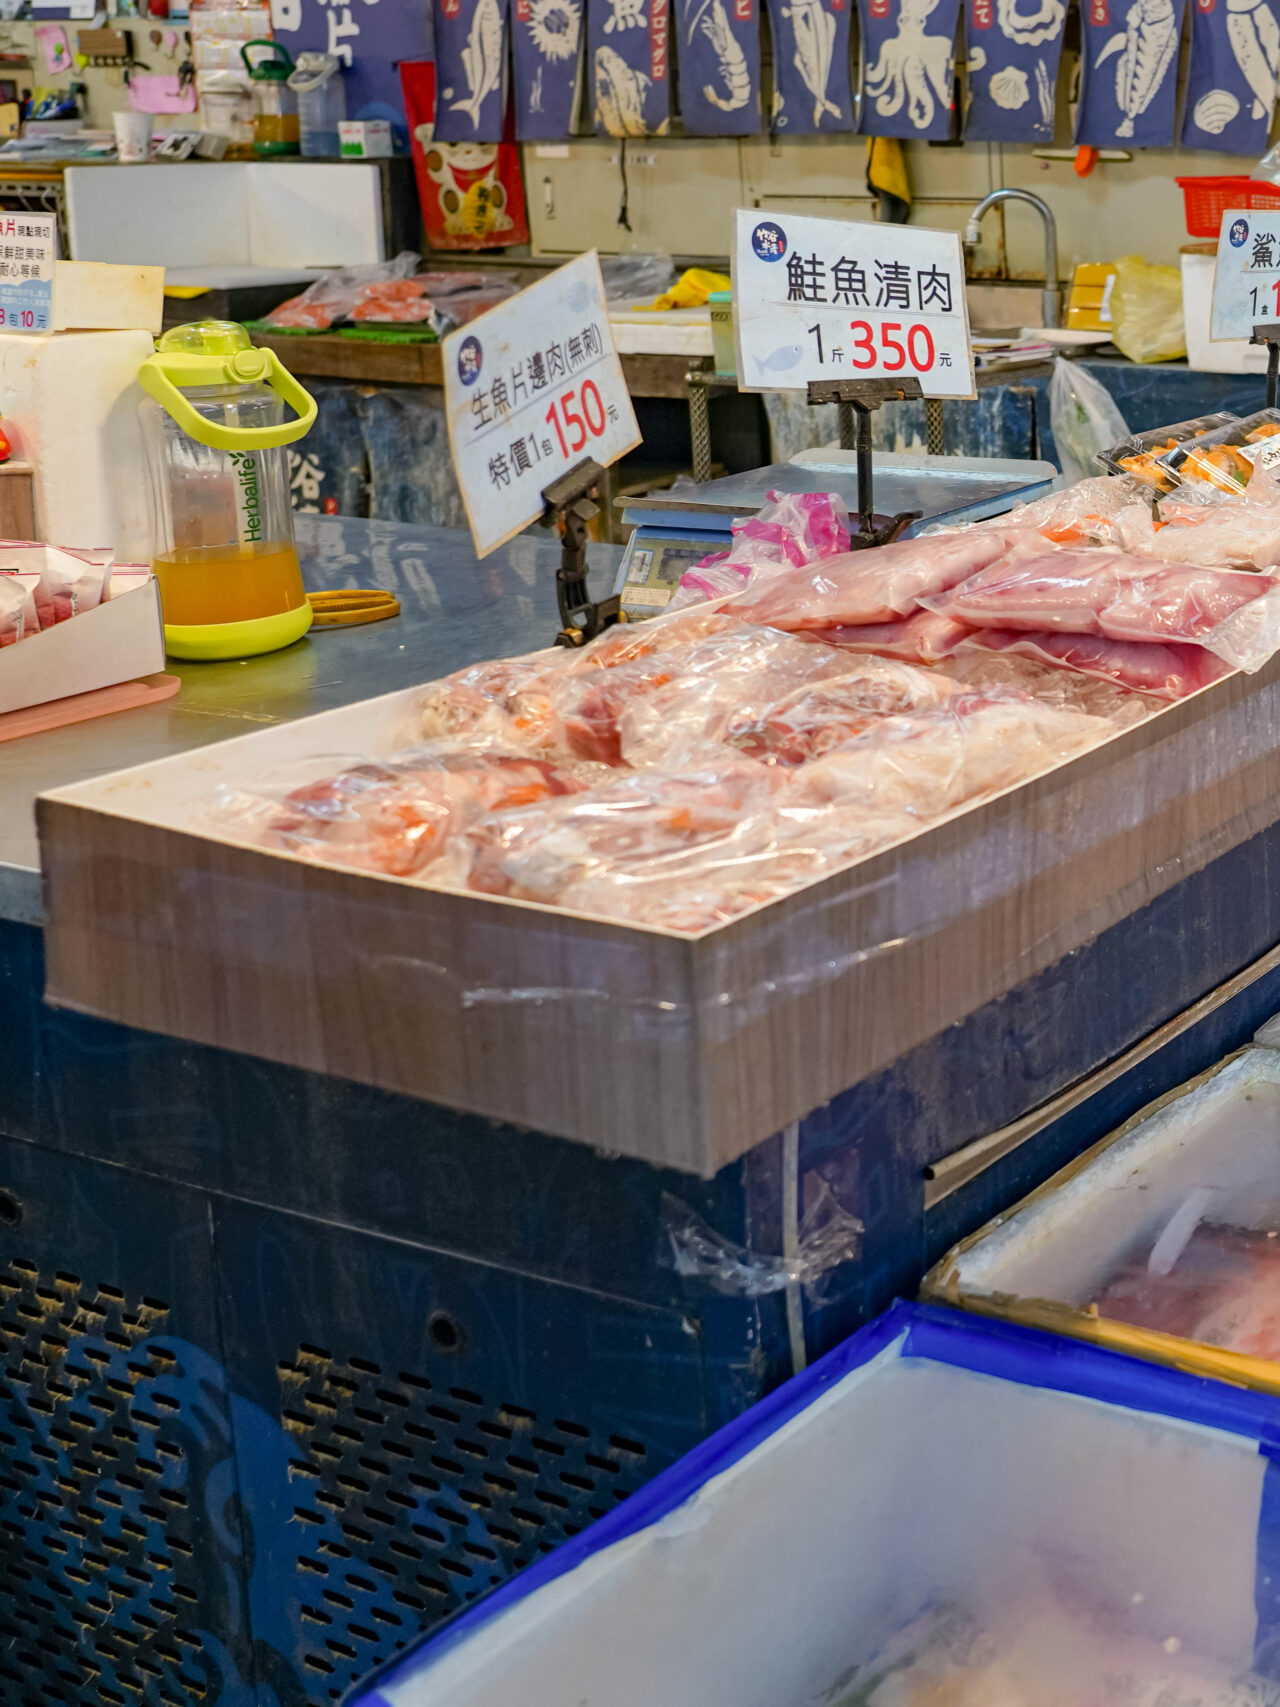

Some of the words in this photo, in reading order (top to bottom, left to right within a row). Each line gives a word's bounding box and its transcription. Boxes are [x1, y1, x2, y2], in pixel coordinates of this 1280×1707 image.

[318, 0, 360, 67] 片
[786, 251, 953, 312] 鮭魚清肉
[238, 457, 262, 542] Herbalife
